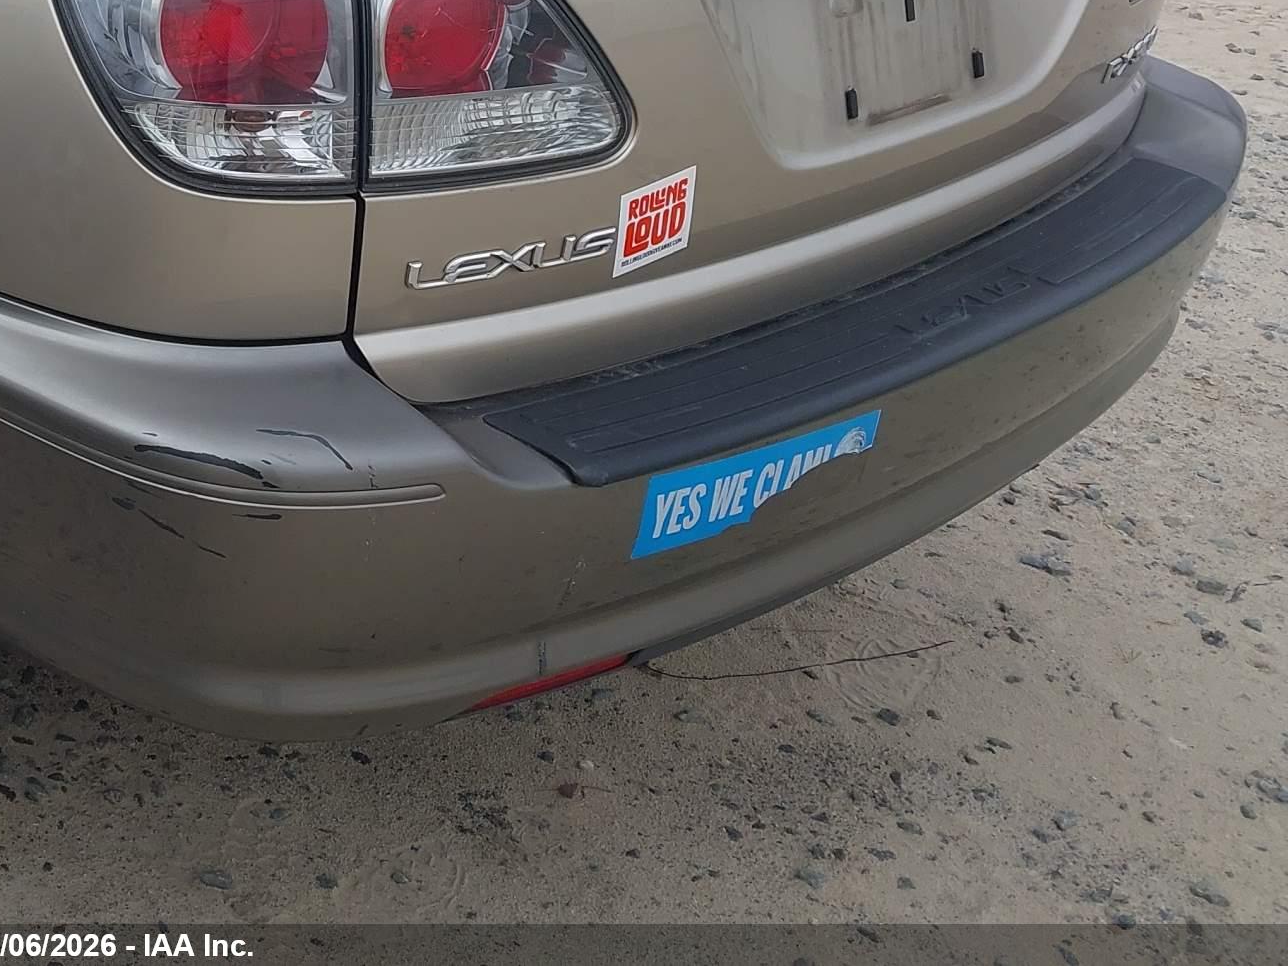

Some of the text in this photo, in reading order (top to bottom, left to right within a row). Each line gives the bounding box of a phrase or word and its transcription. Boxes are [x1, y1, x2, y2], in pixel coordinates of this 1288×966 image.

[623, 200, 687, 258] LOUD
[628, 177, 689, 222] ROLLING
[404, 226, 616, 289] LEXUS
[652, 483, 707, 539] YES
[708, 468, 754, 522] WE
